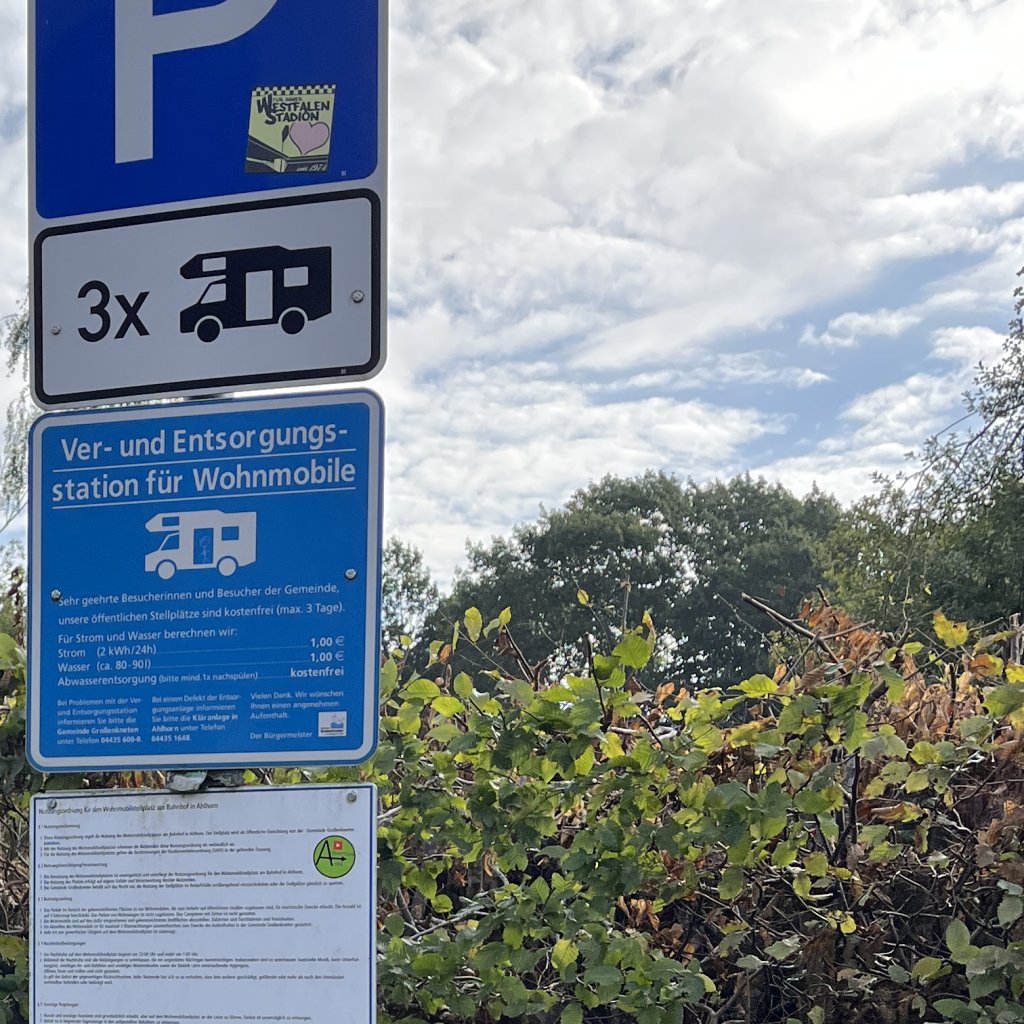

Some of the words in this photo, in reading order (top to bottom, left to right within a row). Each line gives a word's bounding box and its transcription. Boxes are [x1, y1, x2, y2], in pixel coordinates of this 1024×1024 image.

[115, 0, 278, 164] P
[257, 93, 330, 114] WESTFALEN
[264, 109, 320, 125] STADION
[78, 280, 150, 342] 3x
[61, 438, 112, 461] Ver-
[120, 429, 165, 457] und
[173, 423, 348, 453] Entsorgungs-
[52, 473, 139, 502] station
[146, 469, 183, 495] für
[192, 457, 356, 492] Wohnmobile
[59, 596, 79, 606] Sehr
[82, 594, 119, 608] geehrte
[121, 590, 192, 603] Besucherinnen
[195, 588, 214, 599] und
[217, 586, 261, 598] Besucher
[264, 586, 281, 595] der
[284, 582, 340, 595] Gemeinde,
[58, 616, 89, 625] unsere
[91, 611, 148, 623] öffentlichen
[150, 608, 200, 622] Stellplätze
[202, 607, 222, 618] sind
[224, 604, 274, 617] kostenfrei
[277, 603, 303, 615] (max.
[306, 603, 313, 613] 3
[315, 602, 345, 615] Tage).
[58, 633, 73, 644] Für
[76, 632, 104, 643] Strom
[106, 631, 125, 642] und
[127, 630, 161, 641] Wasser
[164, 627, 216, 639] berechnen
[219, 626, 238, 637] wir:
[58, 648, 86, 659] Strom
[97, 646, 106, 658] (2
[108, 644, 157, 656] kWh/24h)
[310, 637, 333, 649] 1,00
[335, 636, 345, 647] €
[58, 662, 91, 673] Wasser
[97, 661, 113, 673] (ca.
[310, 652, 333, 664] 1,00
[335, 651, 345, 662] €
[58, 674, 157, 688] Abwasserentsorgung
[159, 674, 179, 684] (bitte
[212, 671, 259, 681] nachspülen)
[290, 667, 345, 678] kostenfrei
